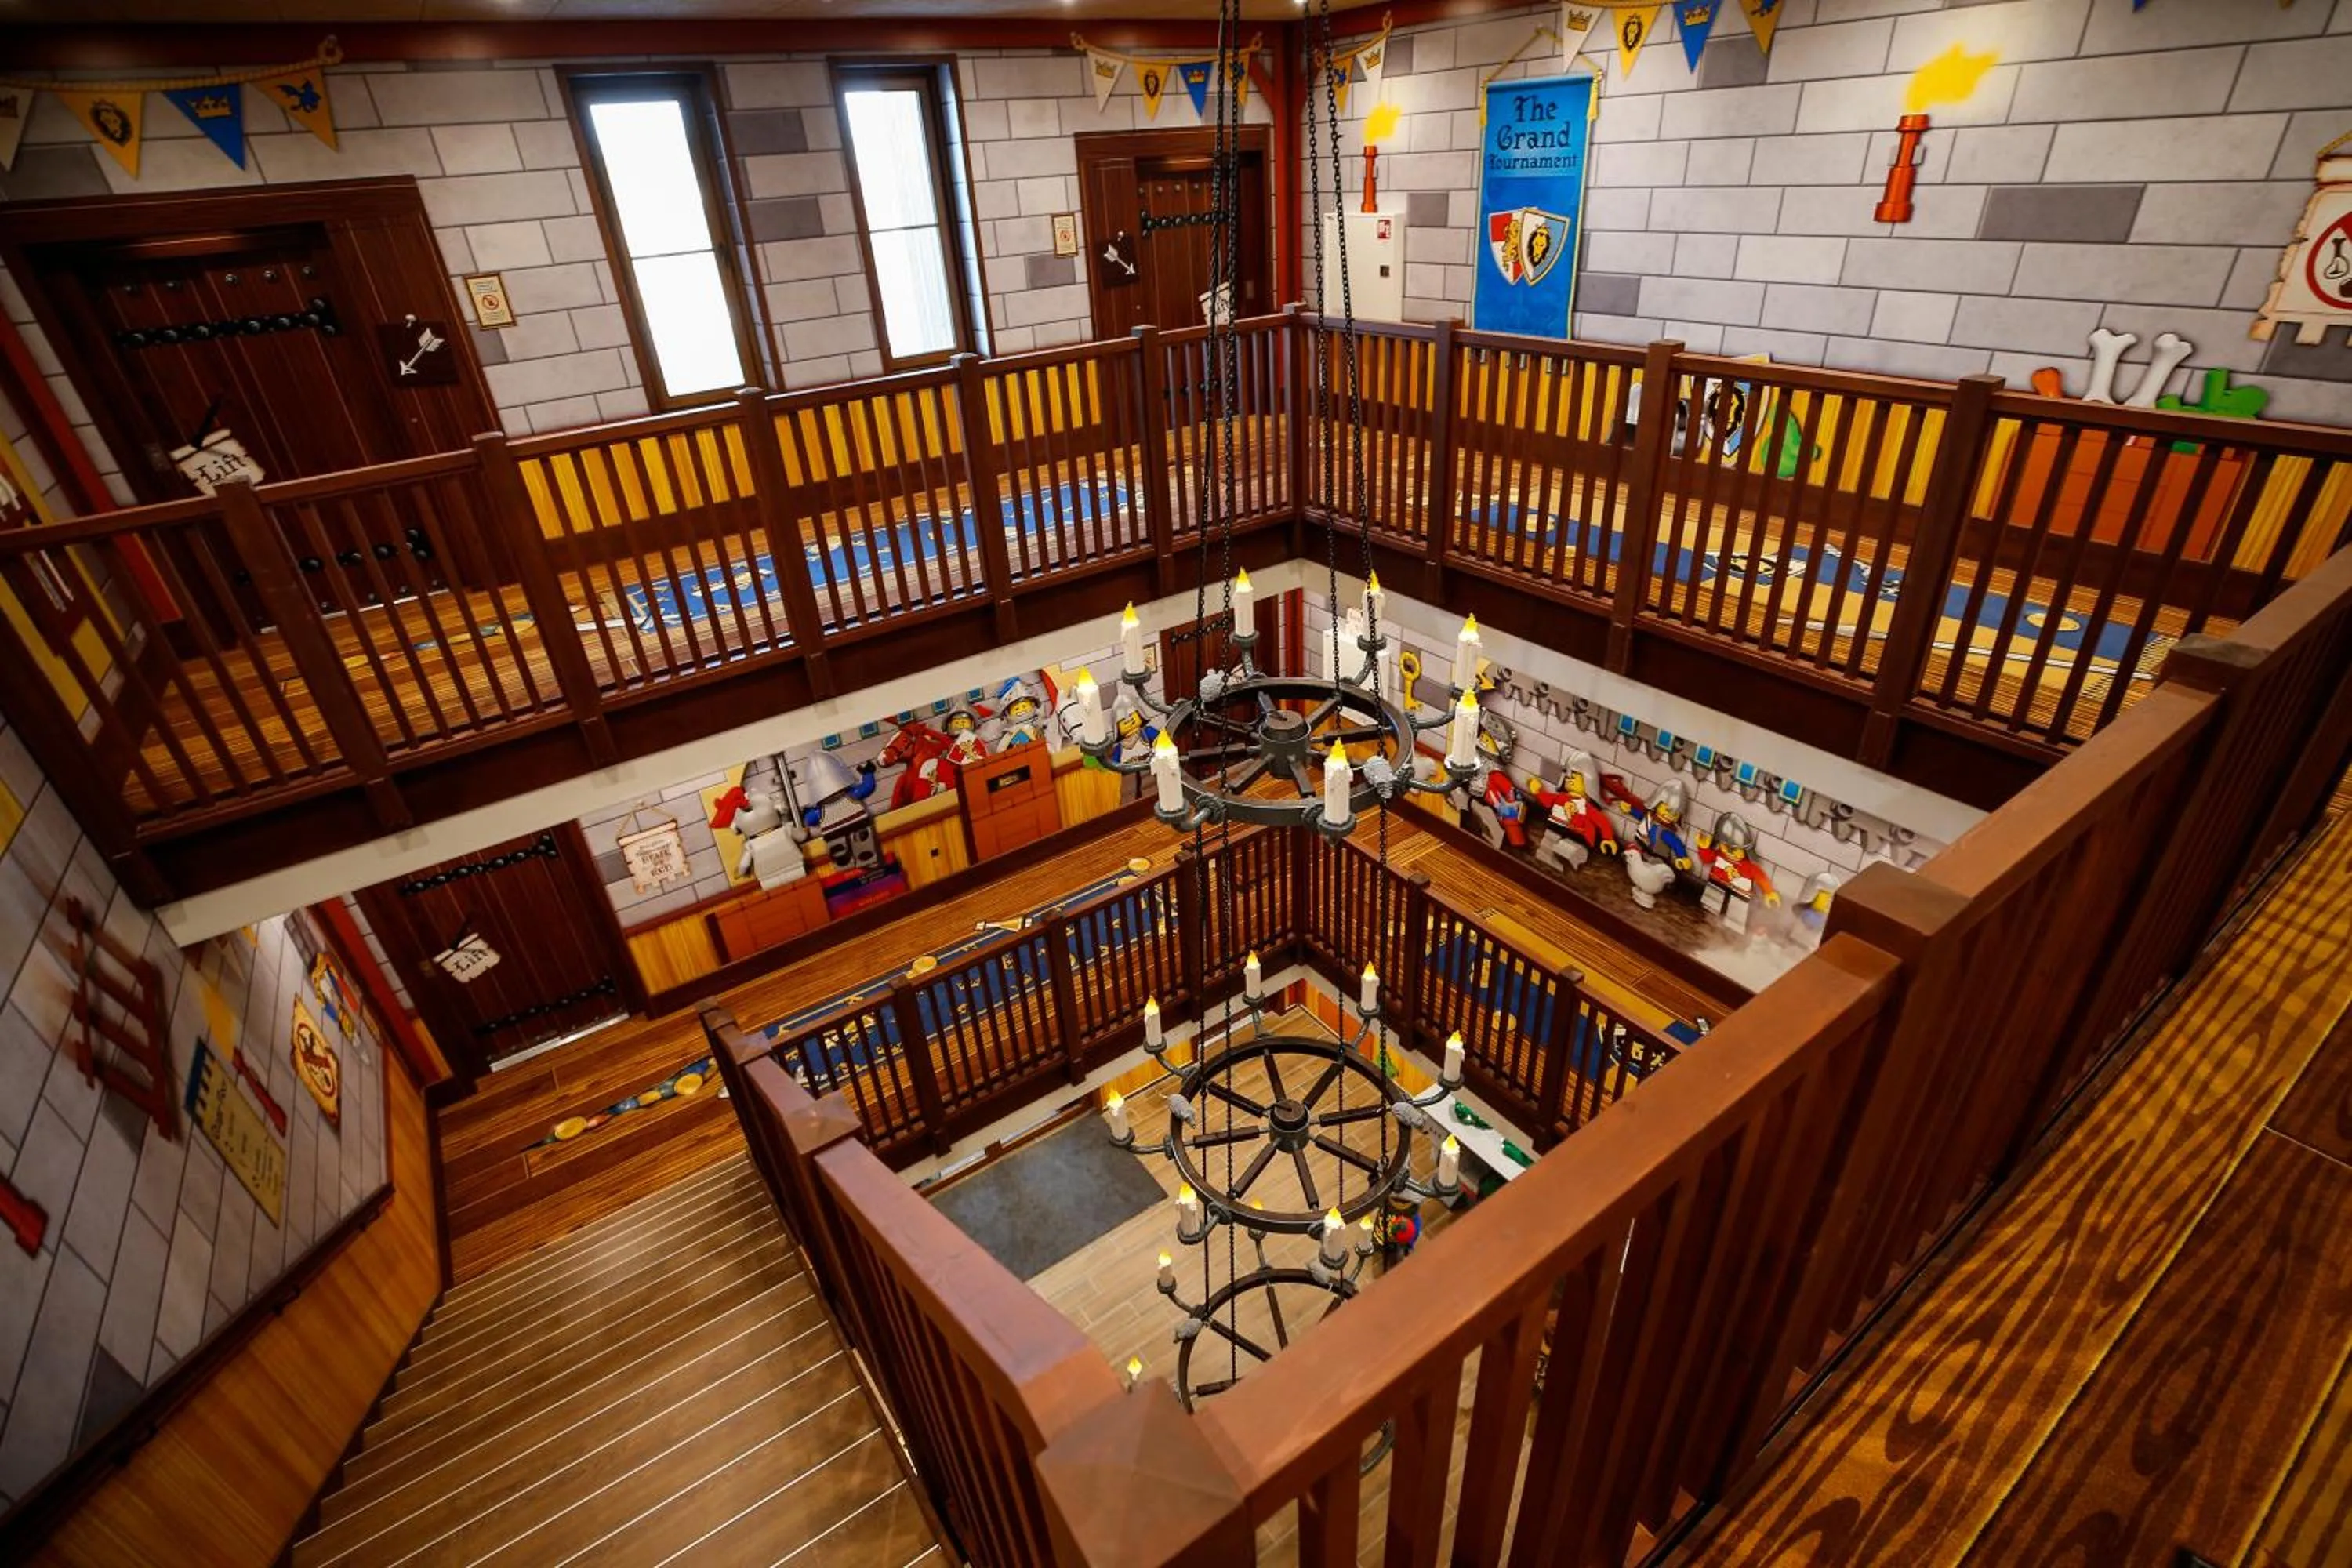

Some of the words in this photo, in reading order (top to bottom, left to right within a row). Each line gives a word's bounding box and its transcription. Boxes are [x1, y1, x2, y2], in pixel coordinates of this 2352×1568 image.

[1514, 94, 1558, 122] The
[1497, 120, 1572, 151] Grand
[1488, 154, 1577, 170] Tournament
[194, 453, 247, 484] Lift
